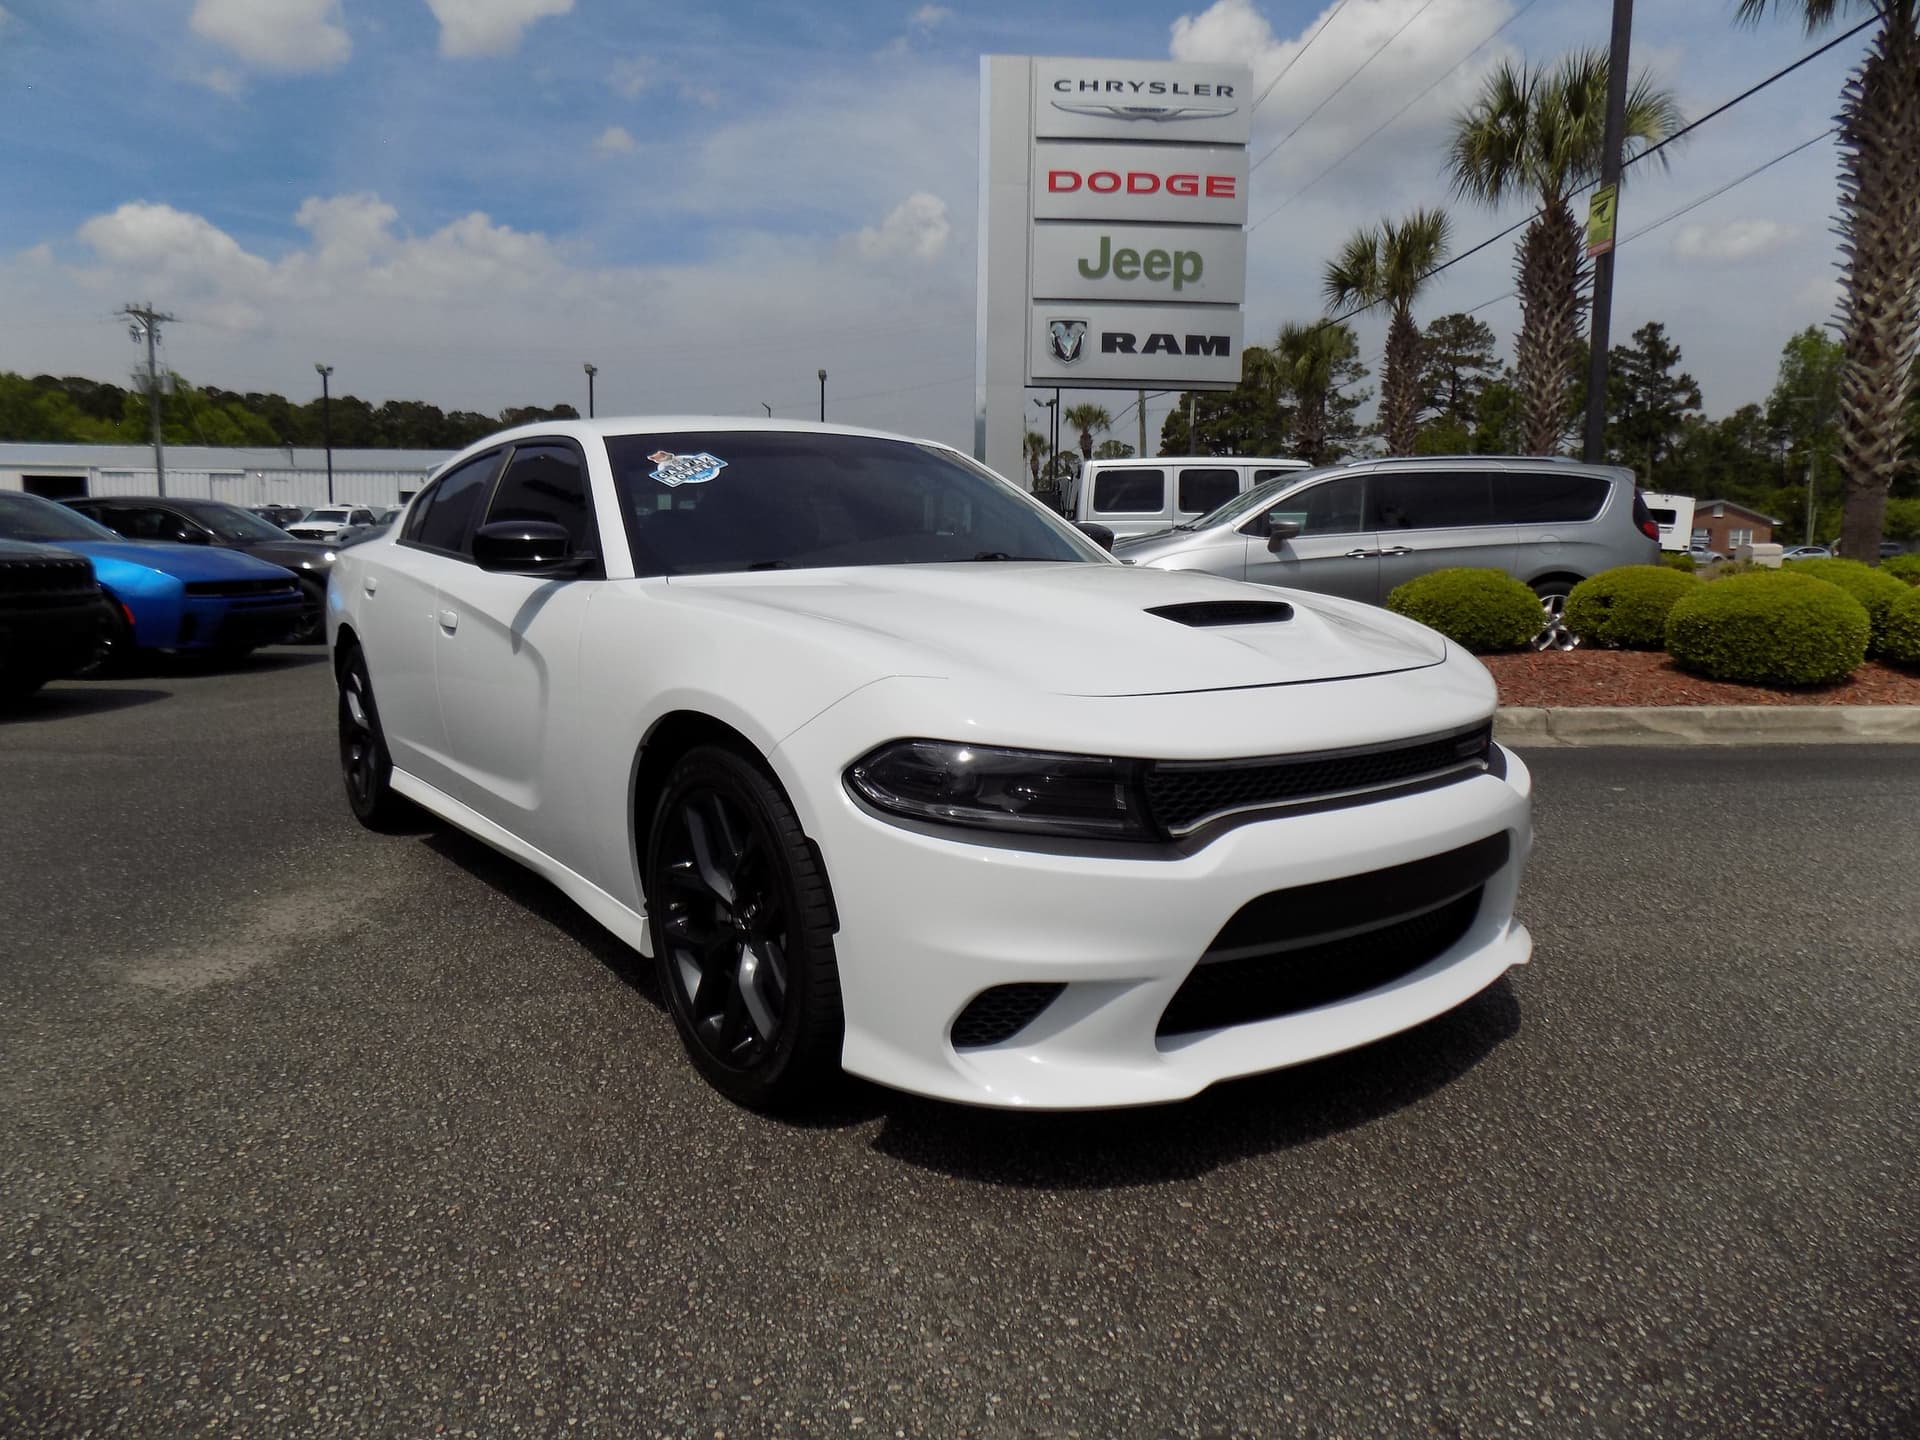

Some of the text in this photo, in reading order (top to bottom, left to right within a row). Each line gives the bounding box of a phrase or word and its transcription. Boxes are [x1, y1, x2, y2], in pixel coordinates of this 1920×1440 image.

[1053, 79, 1234, 98] CHRYSLER
[1048, 170, 1236, 199] DODGE
[1077, 236, 1203, 291] Jeep
[1101, 332, 1231, 357] RAM
